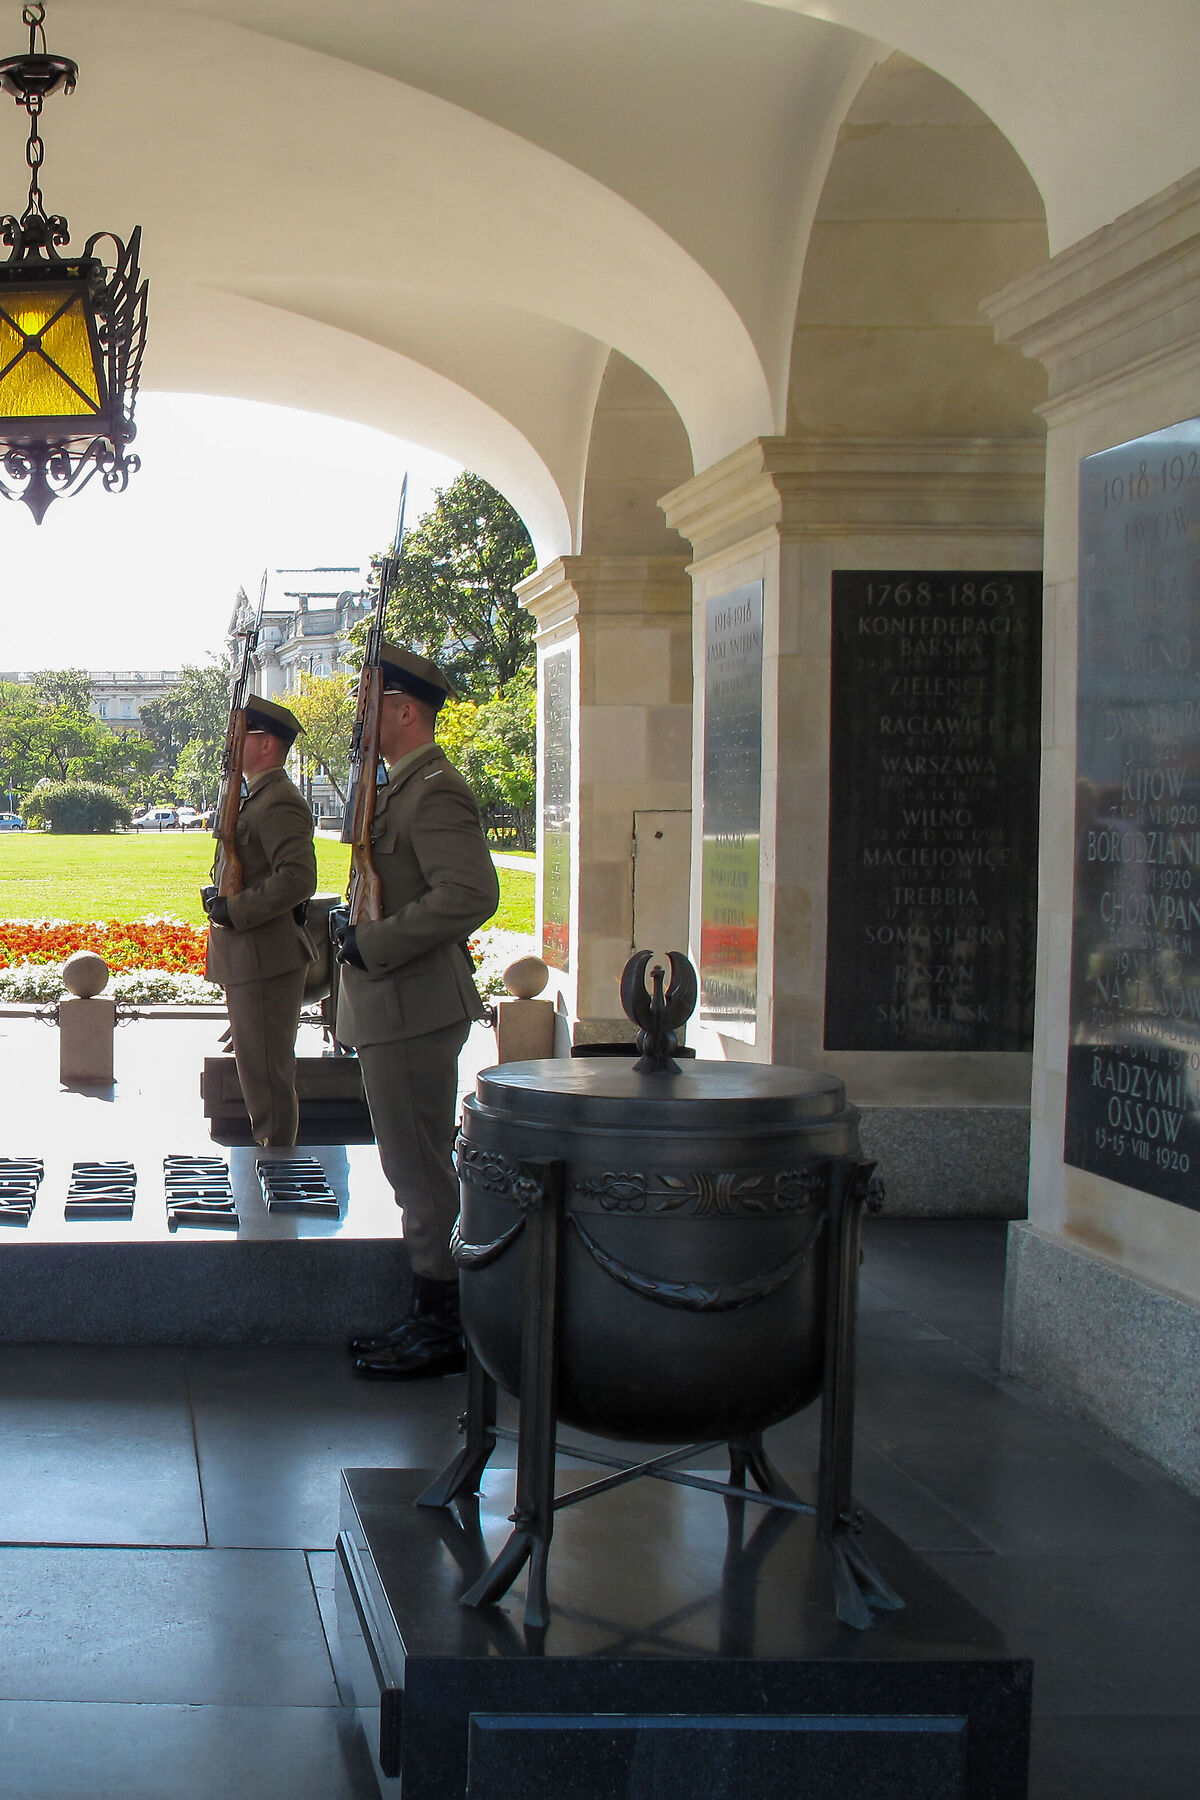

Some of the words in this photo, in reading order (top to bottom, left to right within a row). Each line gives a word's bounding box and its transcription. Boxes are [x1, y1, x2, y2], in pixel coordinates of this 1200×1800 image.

[865, 582, 1015, 607] 1768-1863
[900, 637, 983, 656] BARSKA
[889, 676, 988, 696] ZIELENCE
[880, 756, 997, 775] WARSZAWA
[901, 809, 972, 827] WILNO
[892, 887, 978, 905] TREBBIA
